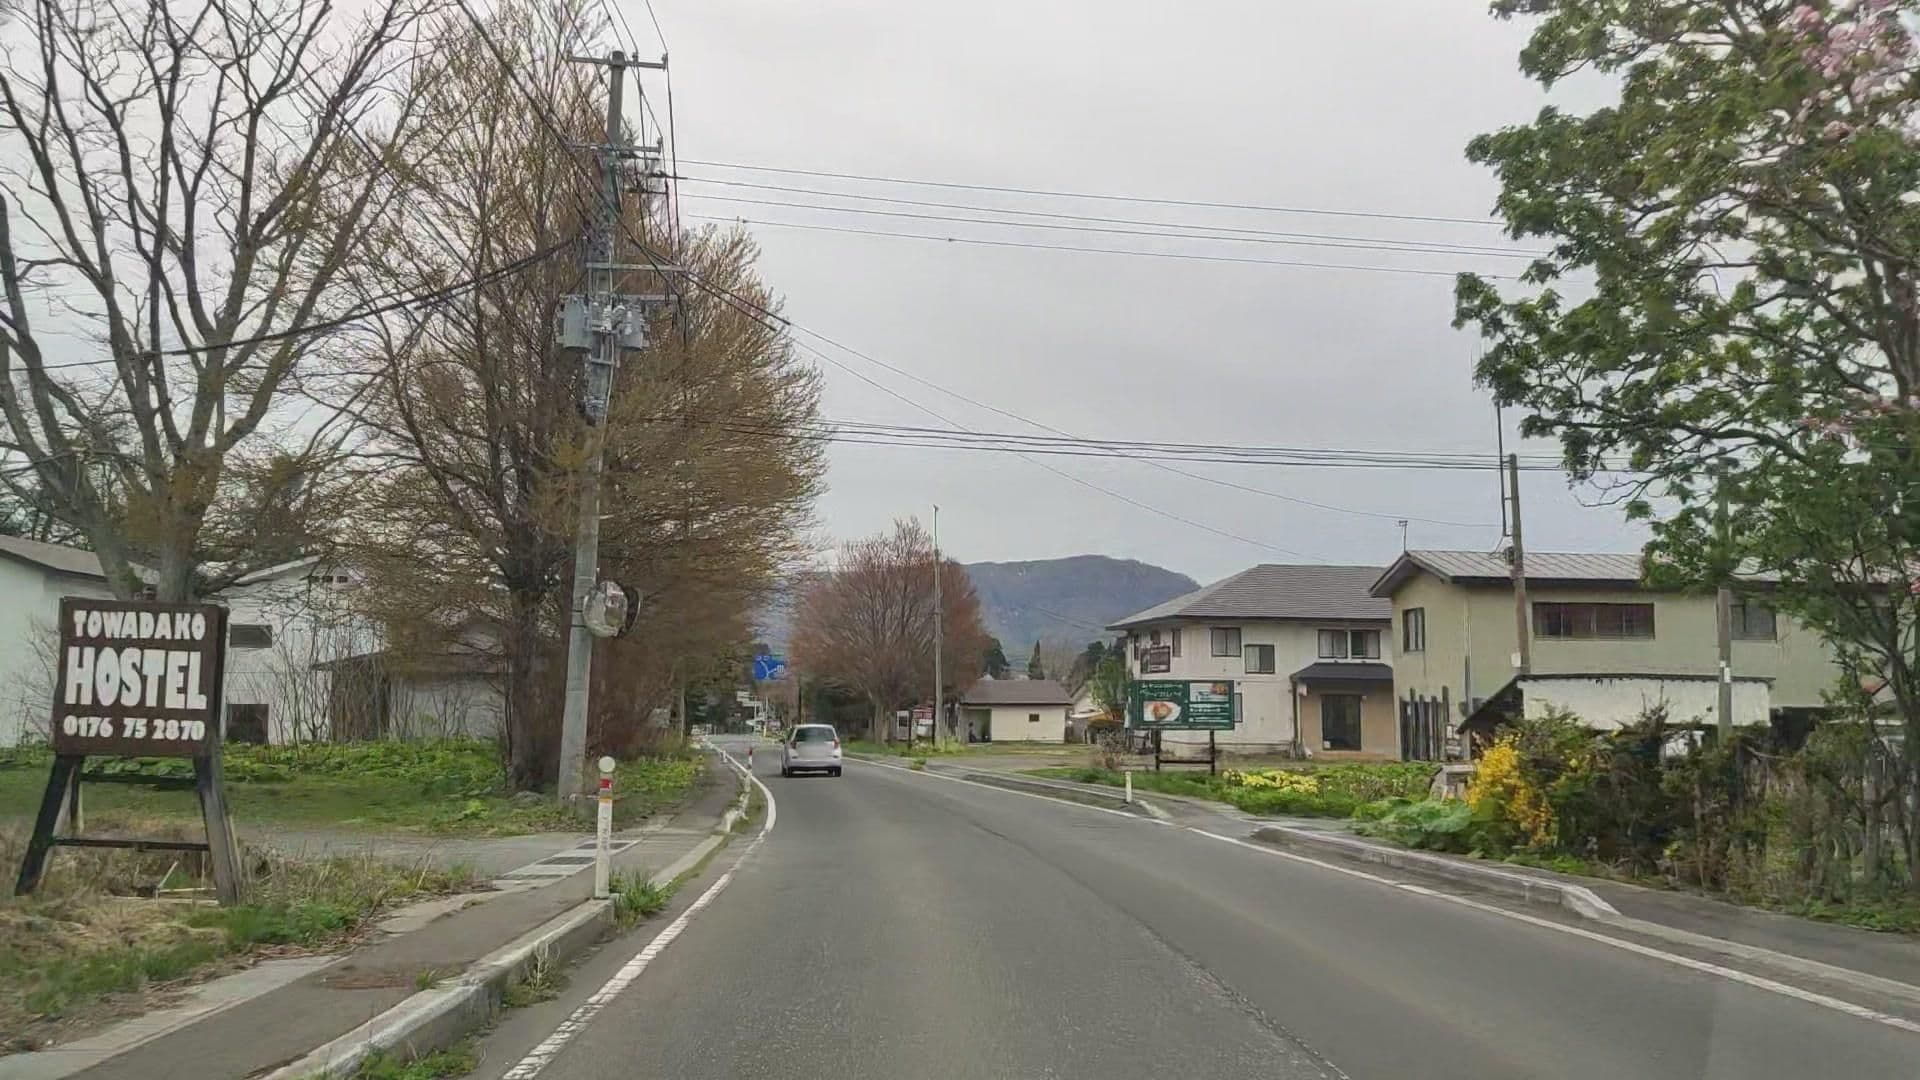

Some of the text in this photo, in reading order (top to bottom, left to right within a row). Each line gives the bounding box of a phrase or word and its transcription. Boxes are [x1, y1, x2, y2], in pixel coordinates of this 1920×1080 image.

[74, 610, 206, 640] TOWADAKO
[64, 646, 207, 709] HOSTEL
[63, 715, 205, 740] 0176 75 2870
